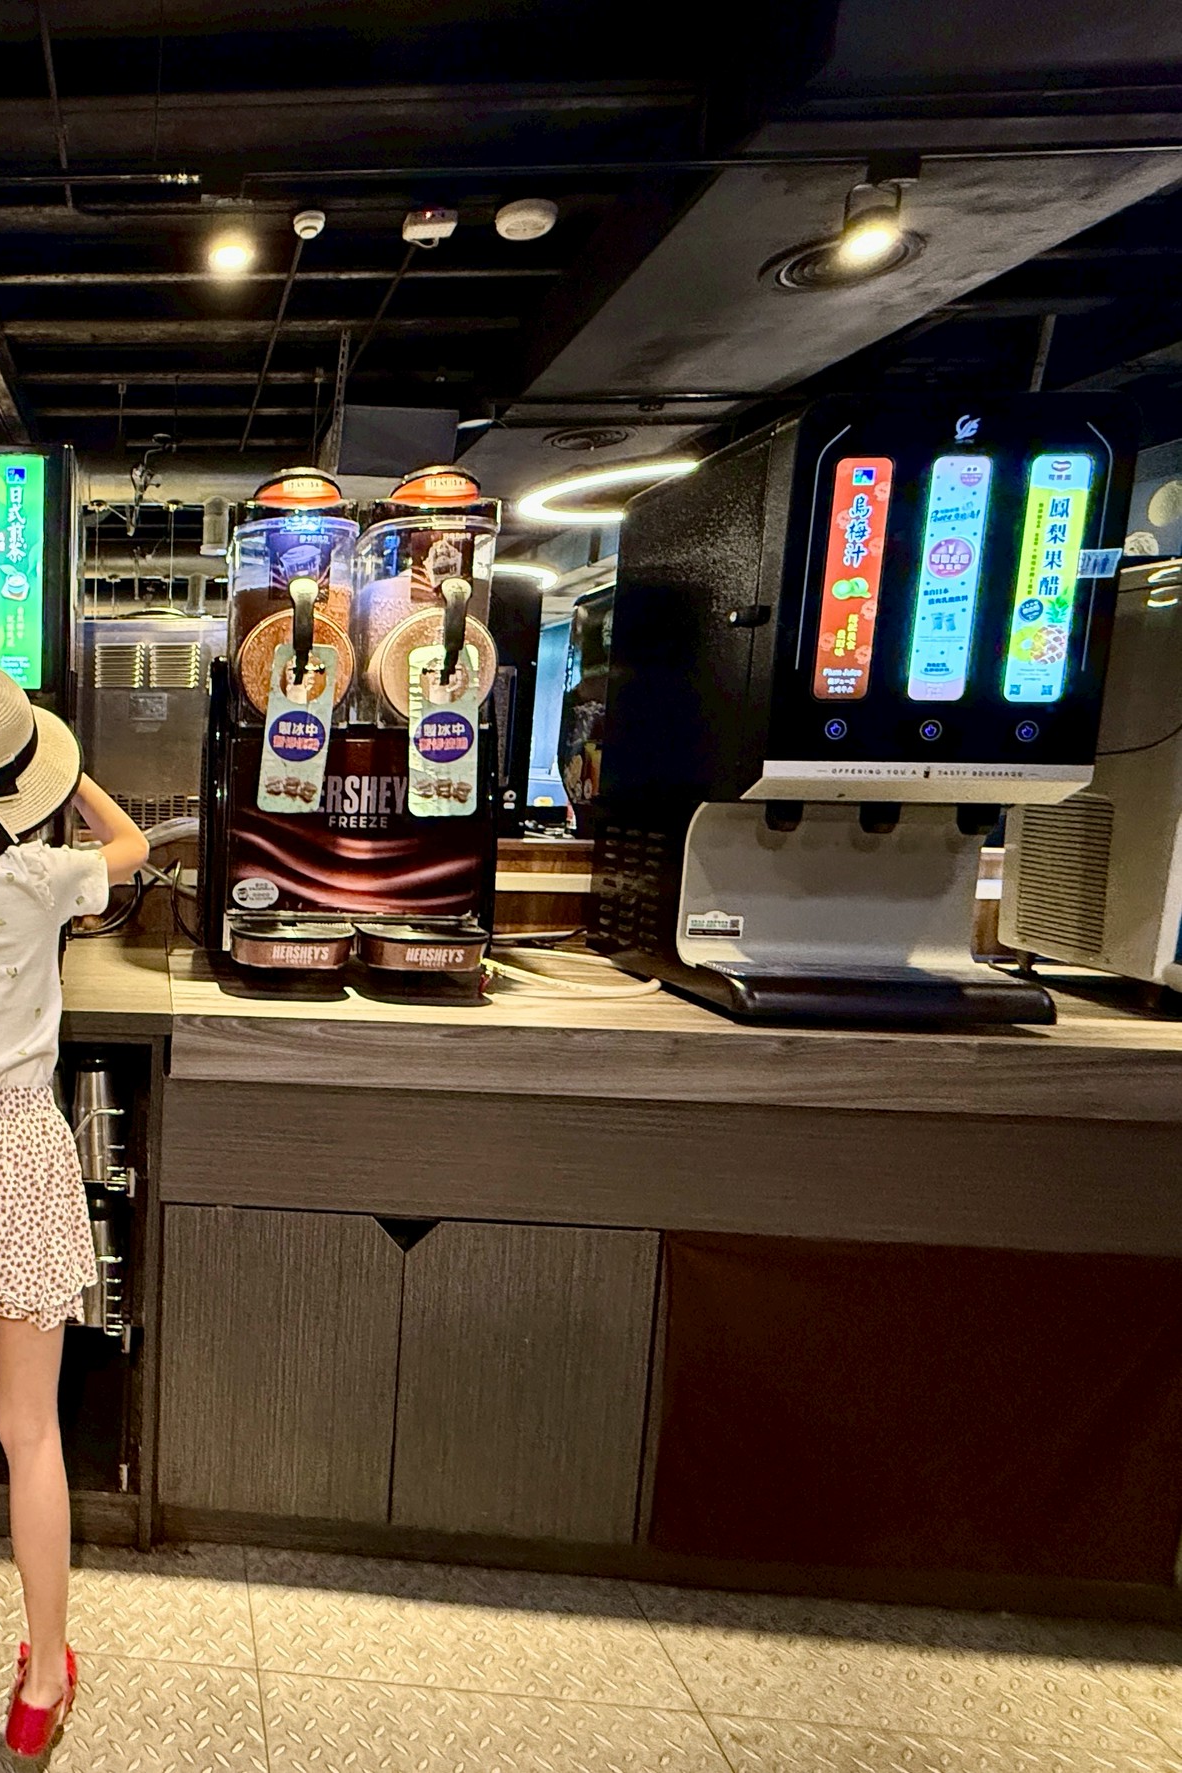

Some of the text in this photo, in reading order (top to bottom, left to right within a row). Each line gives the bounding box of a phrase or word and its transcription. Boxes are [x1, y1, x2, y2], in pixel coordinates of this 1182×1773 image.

[843, 493, 872, 568] 烏梅汁
[1039, 498, 1070, 596] 鳳梨果醋
[329, 815, 388, 829] FREEZE
[272, 945, 329, 961] HERSHEY'S
[405, 947, 465, 963] HERSHEY'S
